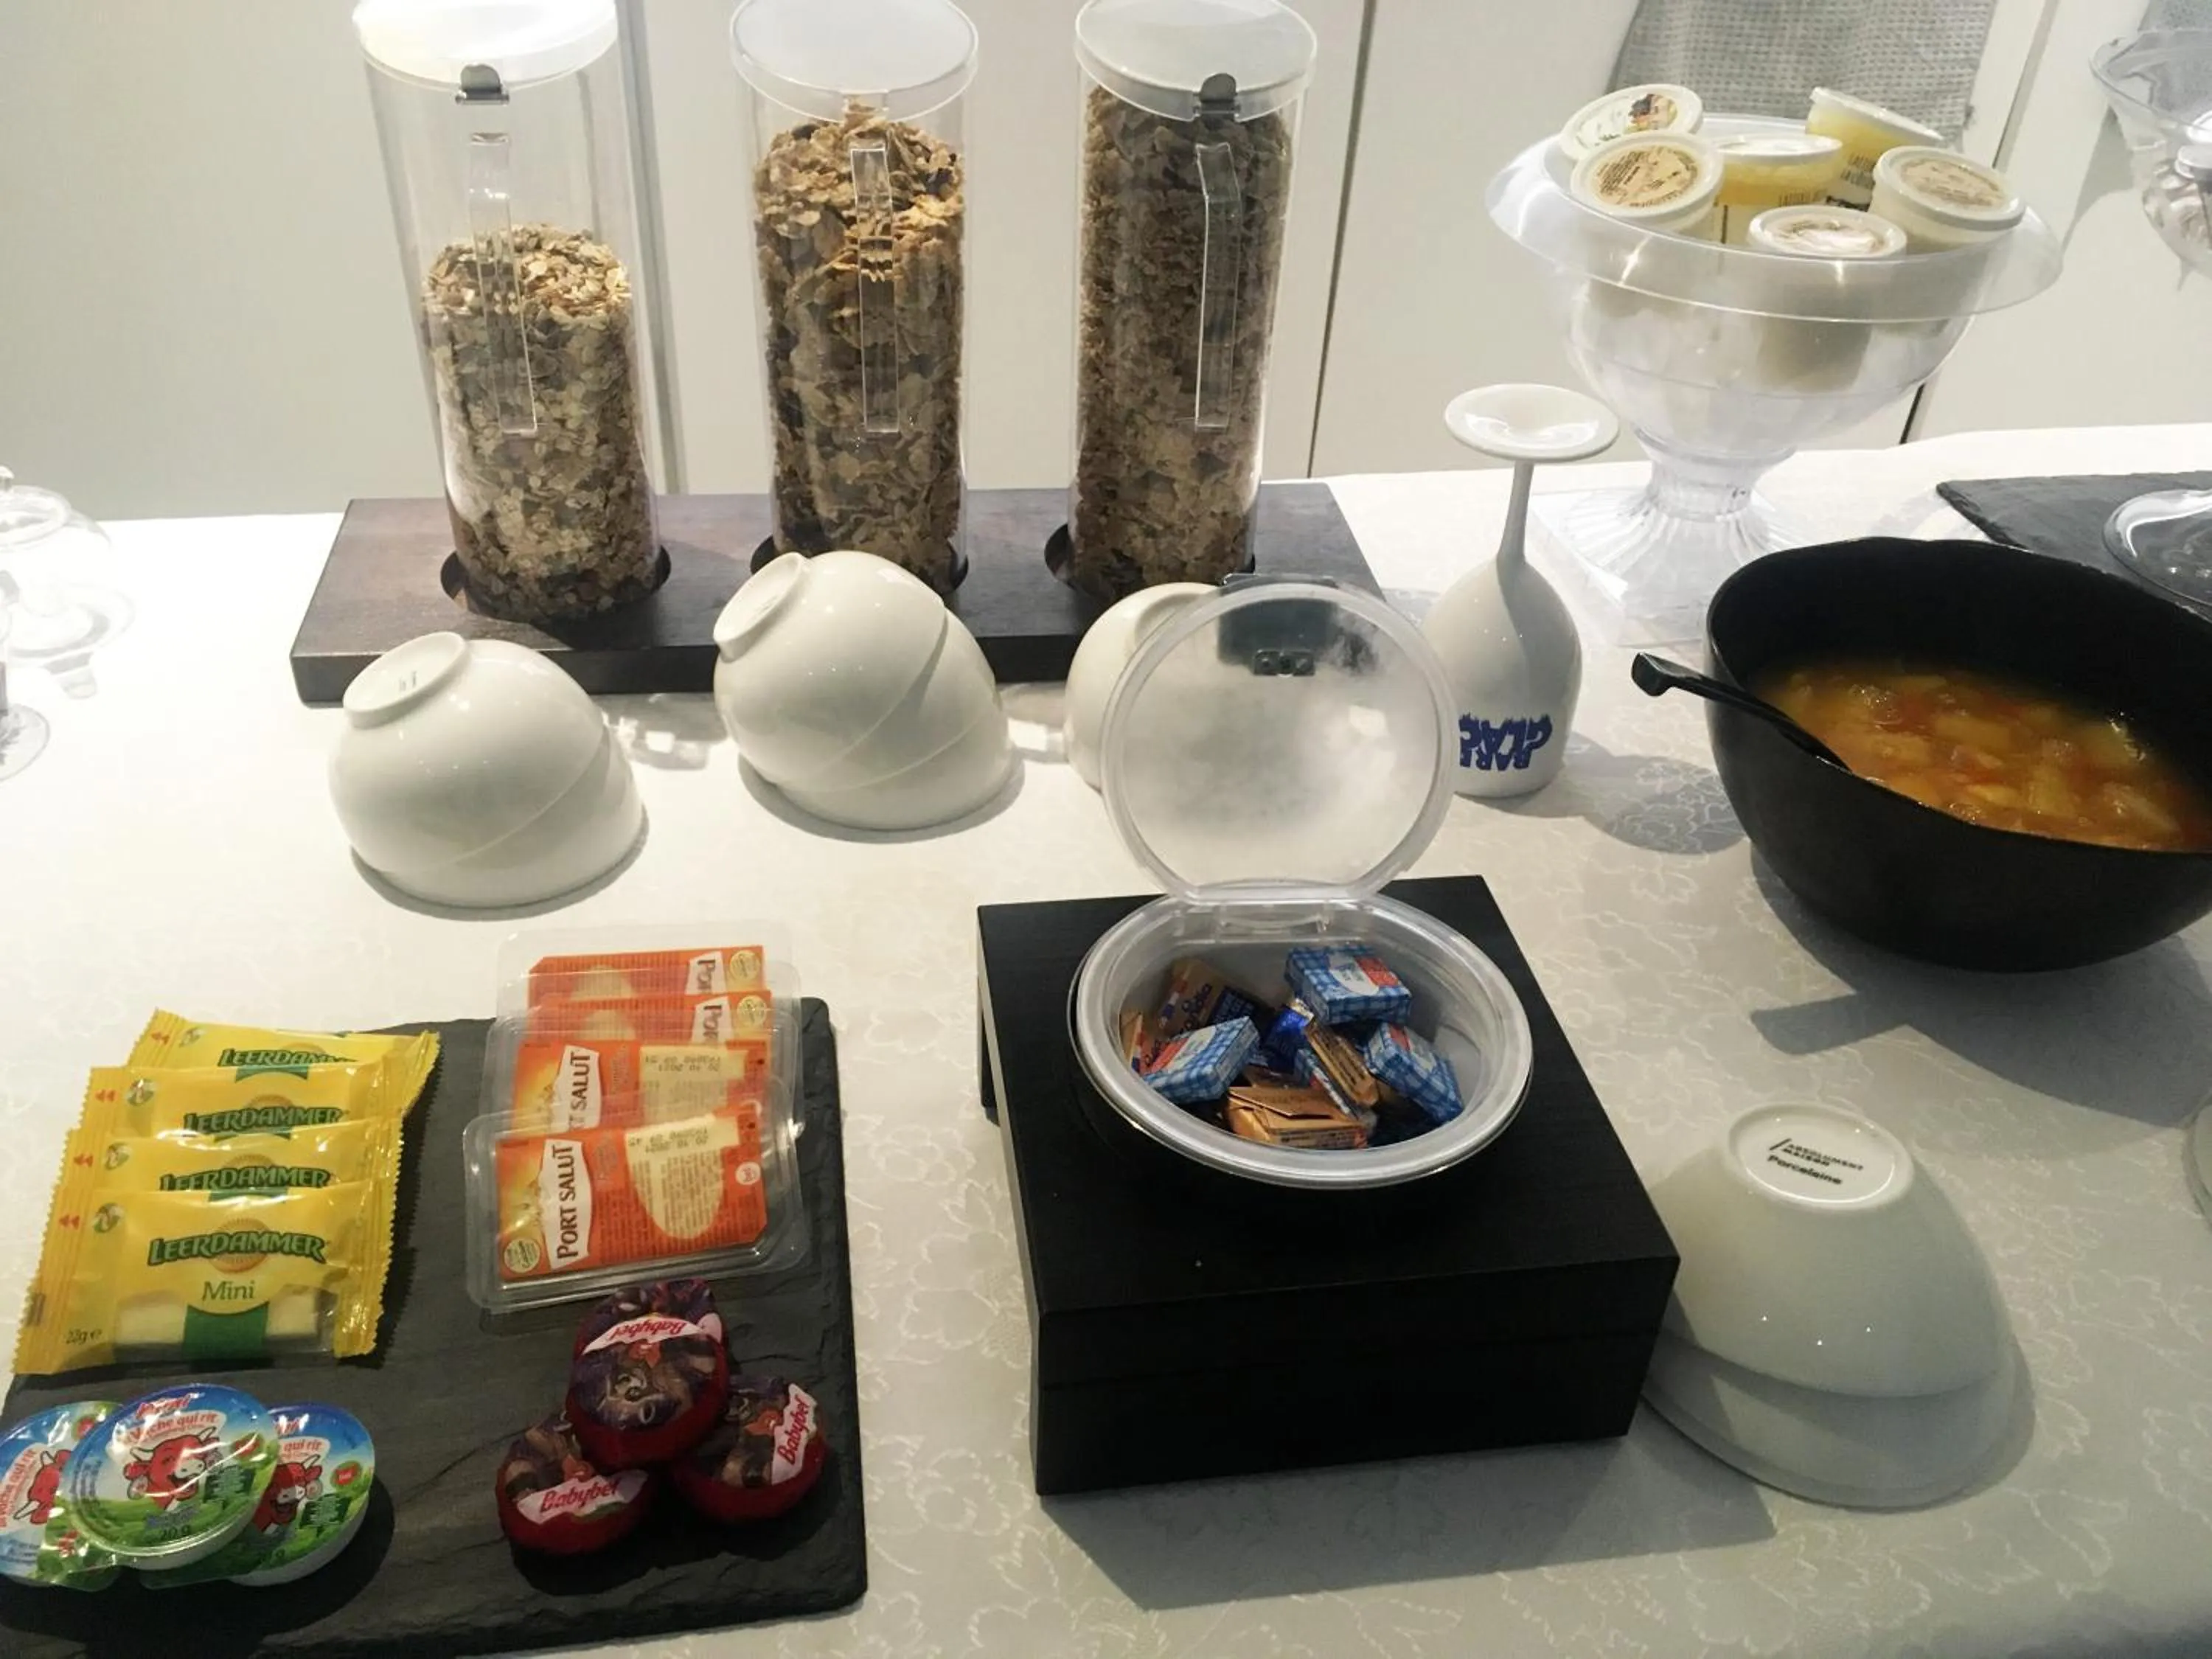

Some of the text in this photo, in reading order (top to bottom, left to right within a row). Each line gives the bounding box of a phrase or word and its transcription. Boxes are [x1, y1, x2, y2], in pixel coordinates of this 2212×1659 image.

[570, 1051, 591, 1111] SALUT
[183, 1107, 344, 1138] LEERDAMMER
[159, 1166, 330, 1191] LEERDAMMER
[552, 1144, 579, 1259] PORT SALUT
[147, 1231, 327, 1266] LEERDAMMER
[201, 1279, 255, 1303] Mini
[611, 1316, 686, 1340] Babybel
[776, 1395, 811, 1465] Babybel
[539, 1479, 621, 1513] Babybel
